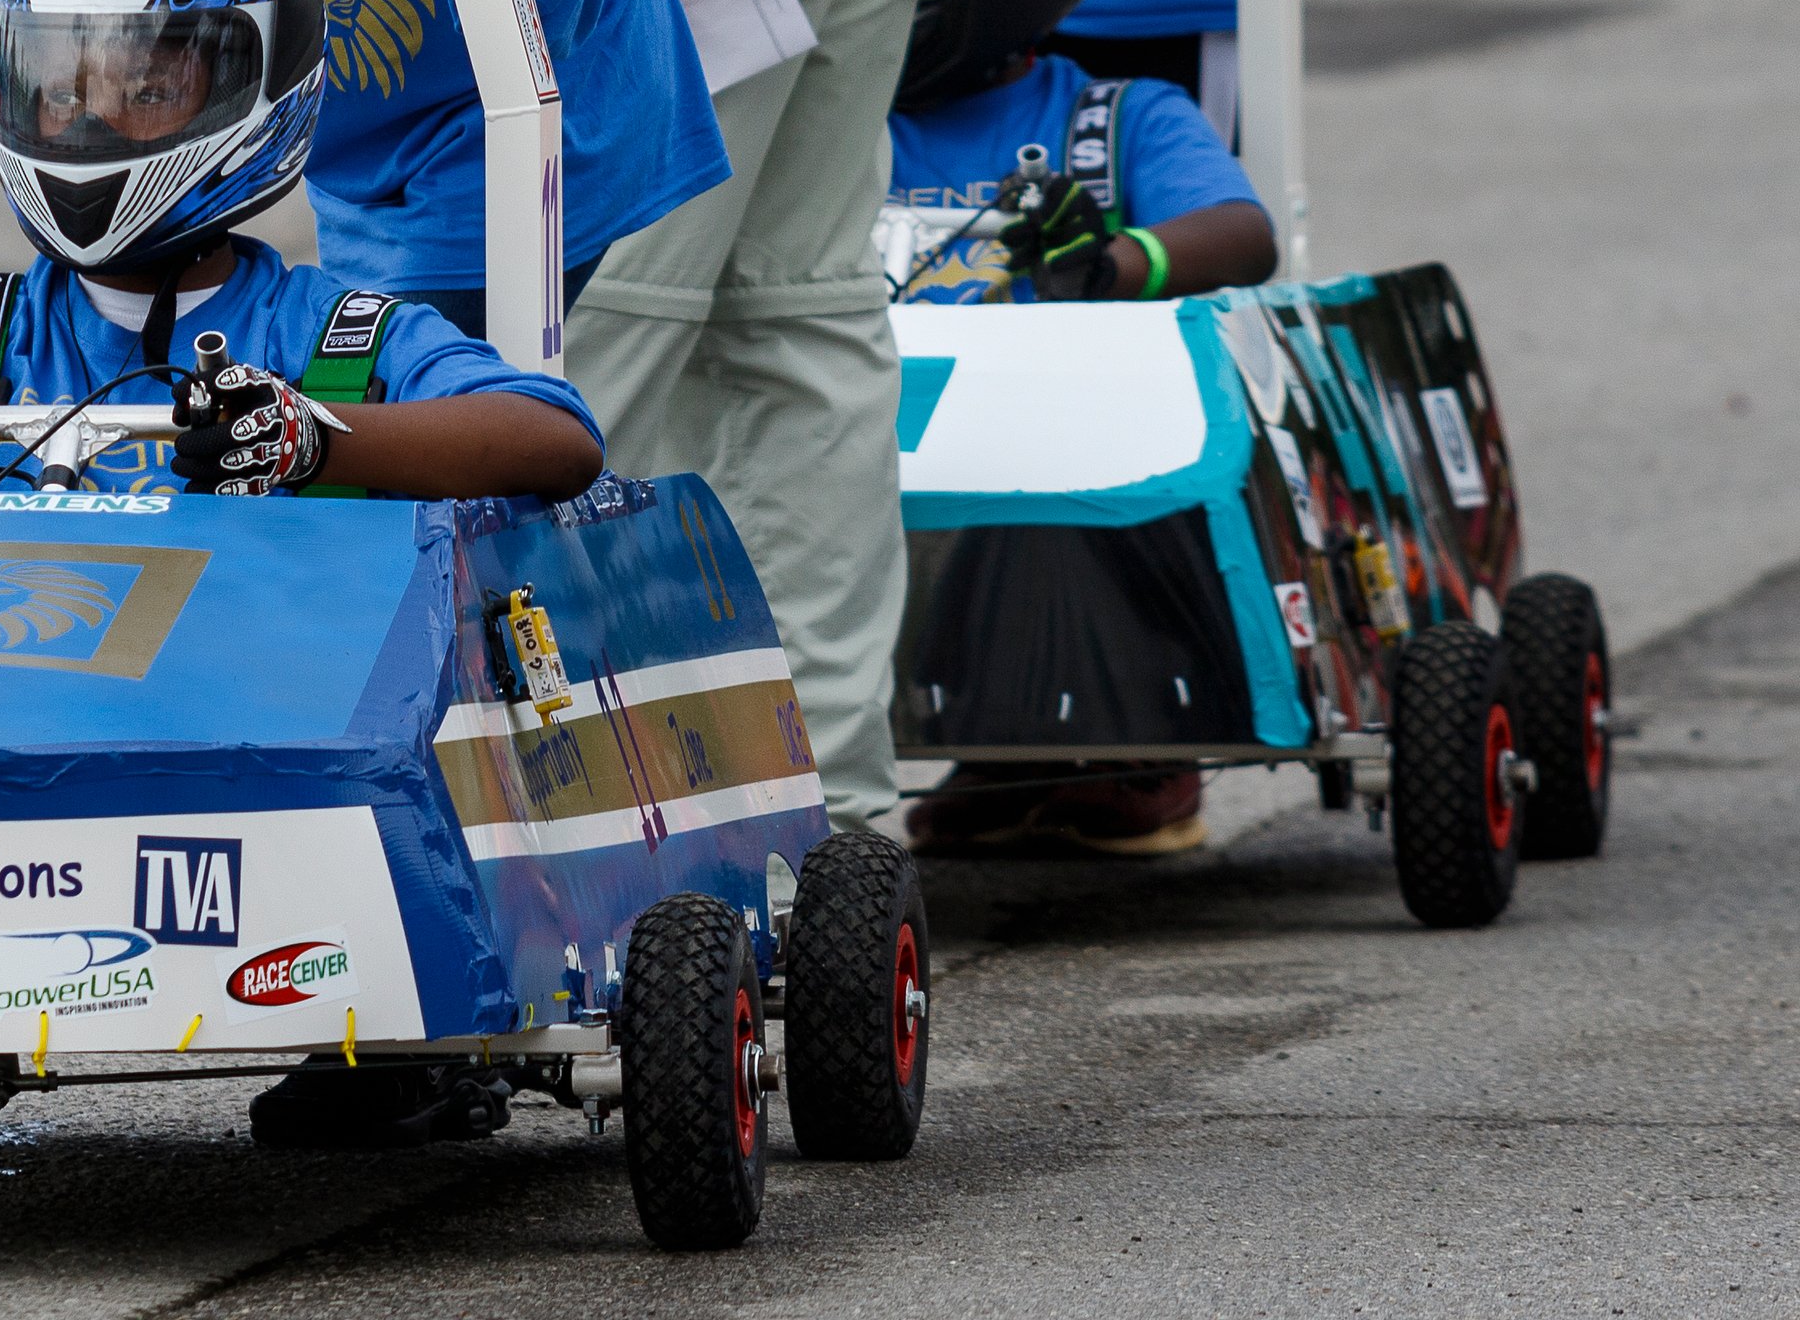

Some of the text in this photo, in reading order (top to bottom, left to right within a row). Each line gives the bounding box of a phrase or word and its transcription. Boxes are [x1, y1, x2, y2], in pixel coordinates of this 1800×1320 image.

[139, 849, 236, 934] TVA
[54, 995, 148, 1017] INSPIRING INNOVATION
